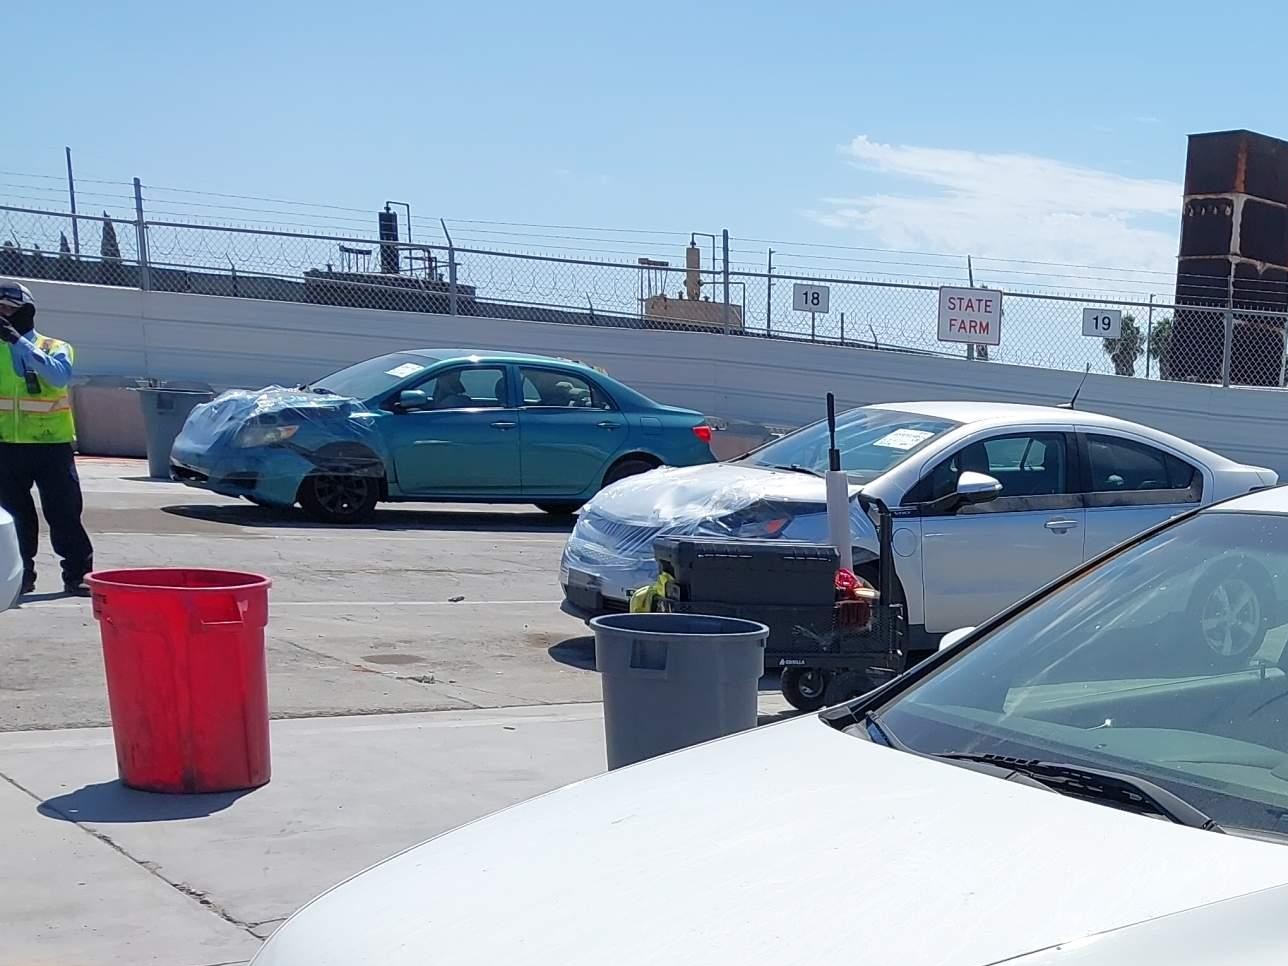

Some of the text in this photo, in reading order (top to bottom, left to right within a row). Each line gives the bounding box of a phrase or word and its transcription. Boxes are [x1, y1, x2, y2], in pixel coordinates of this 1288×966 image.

[802, 290, 820, 306] 18
[947, 296, 993, 314] STATE
[949, 318, 990, 335] FARM
[1092, 315, 1111, 331] 19
